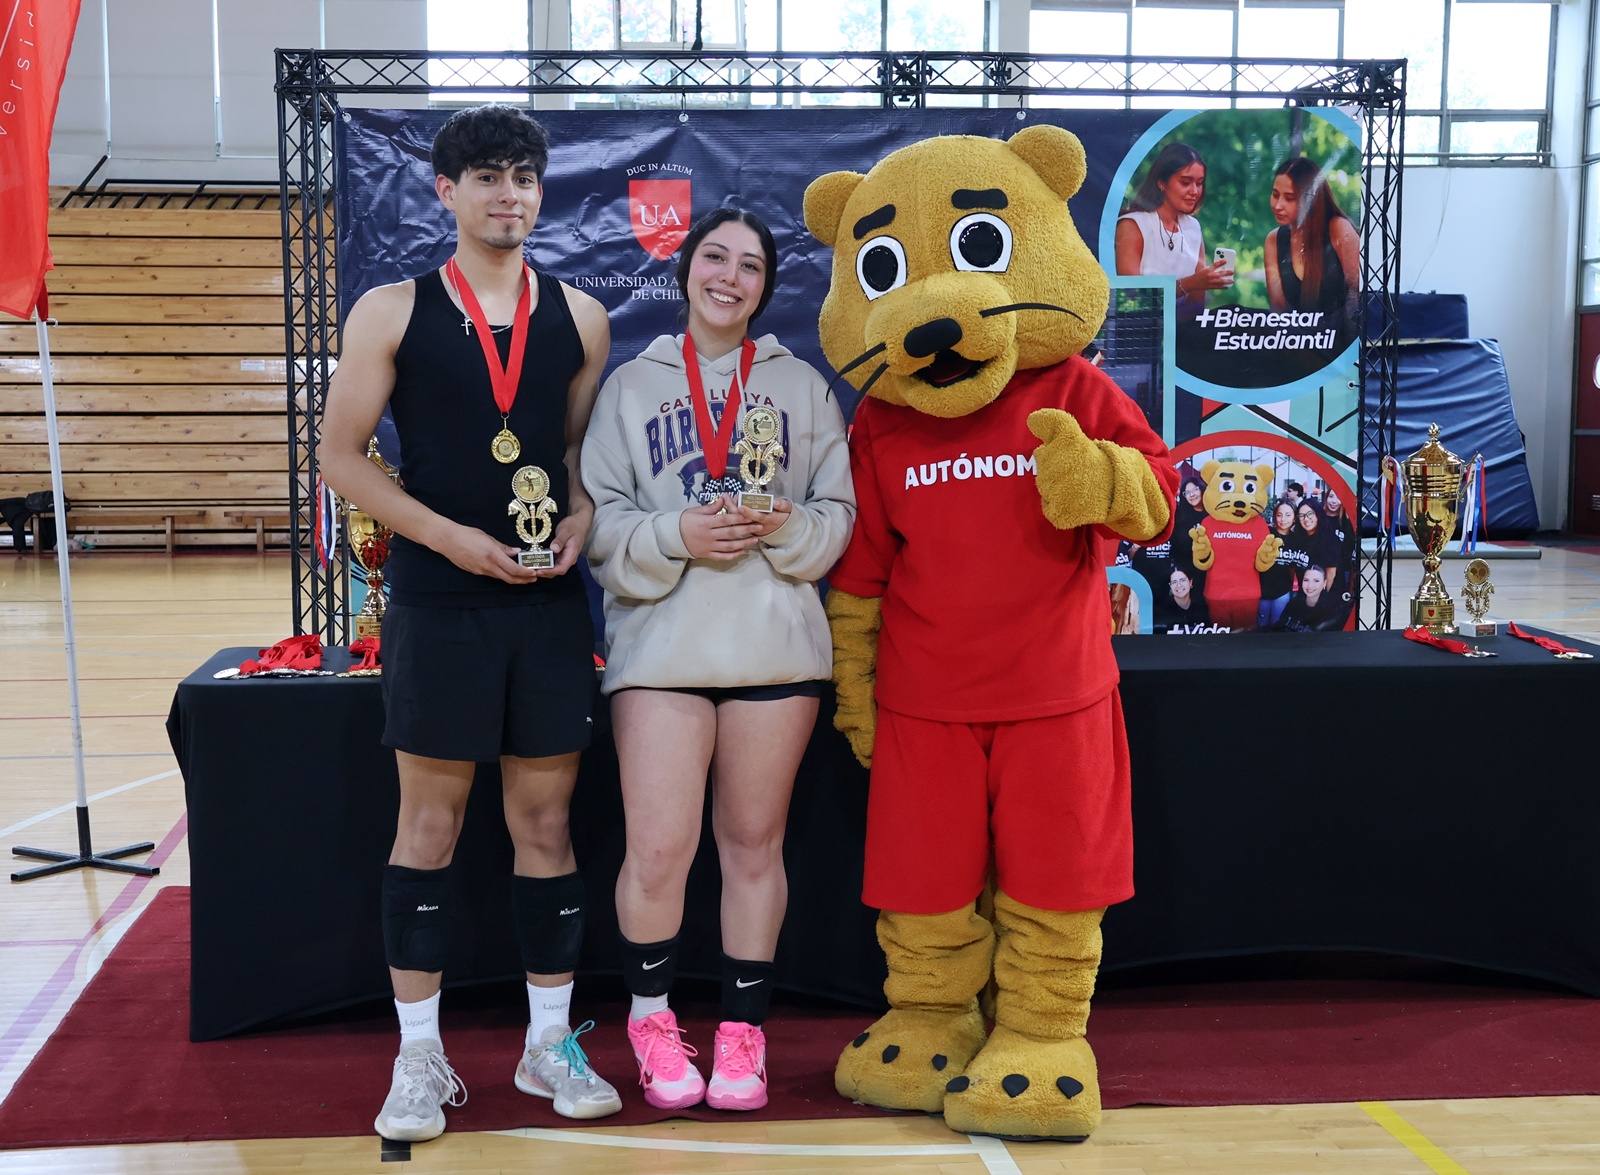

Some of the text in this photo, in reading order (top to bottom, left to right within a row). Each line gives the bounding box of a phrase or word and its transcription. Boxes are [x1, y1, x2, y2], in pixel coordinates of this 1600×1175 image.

[626, 163, 693, 177] DUC IN ALTUM
[638, 204, 682, 226] UA
[575, 276, 668, 288] UNIVERSIDAD
[632, 289, 685, 300] DE CHIL
[1195, 307, 1324, 328] +Bienestar
[1214, 329, 1337, 351] Estudiantil
[905, 453, 1038, 490] AUTÓNOM
[1213, 531, 1252, 540] AUTÓNOMA
